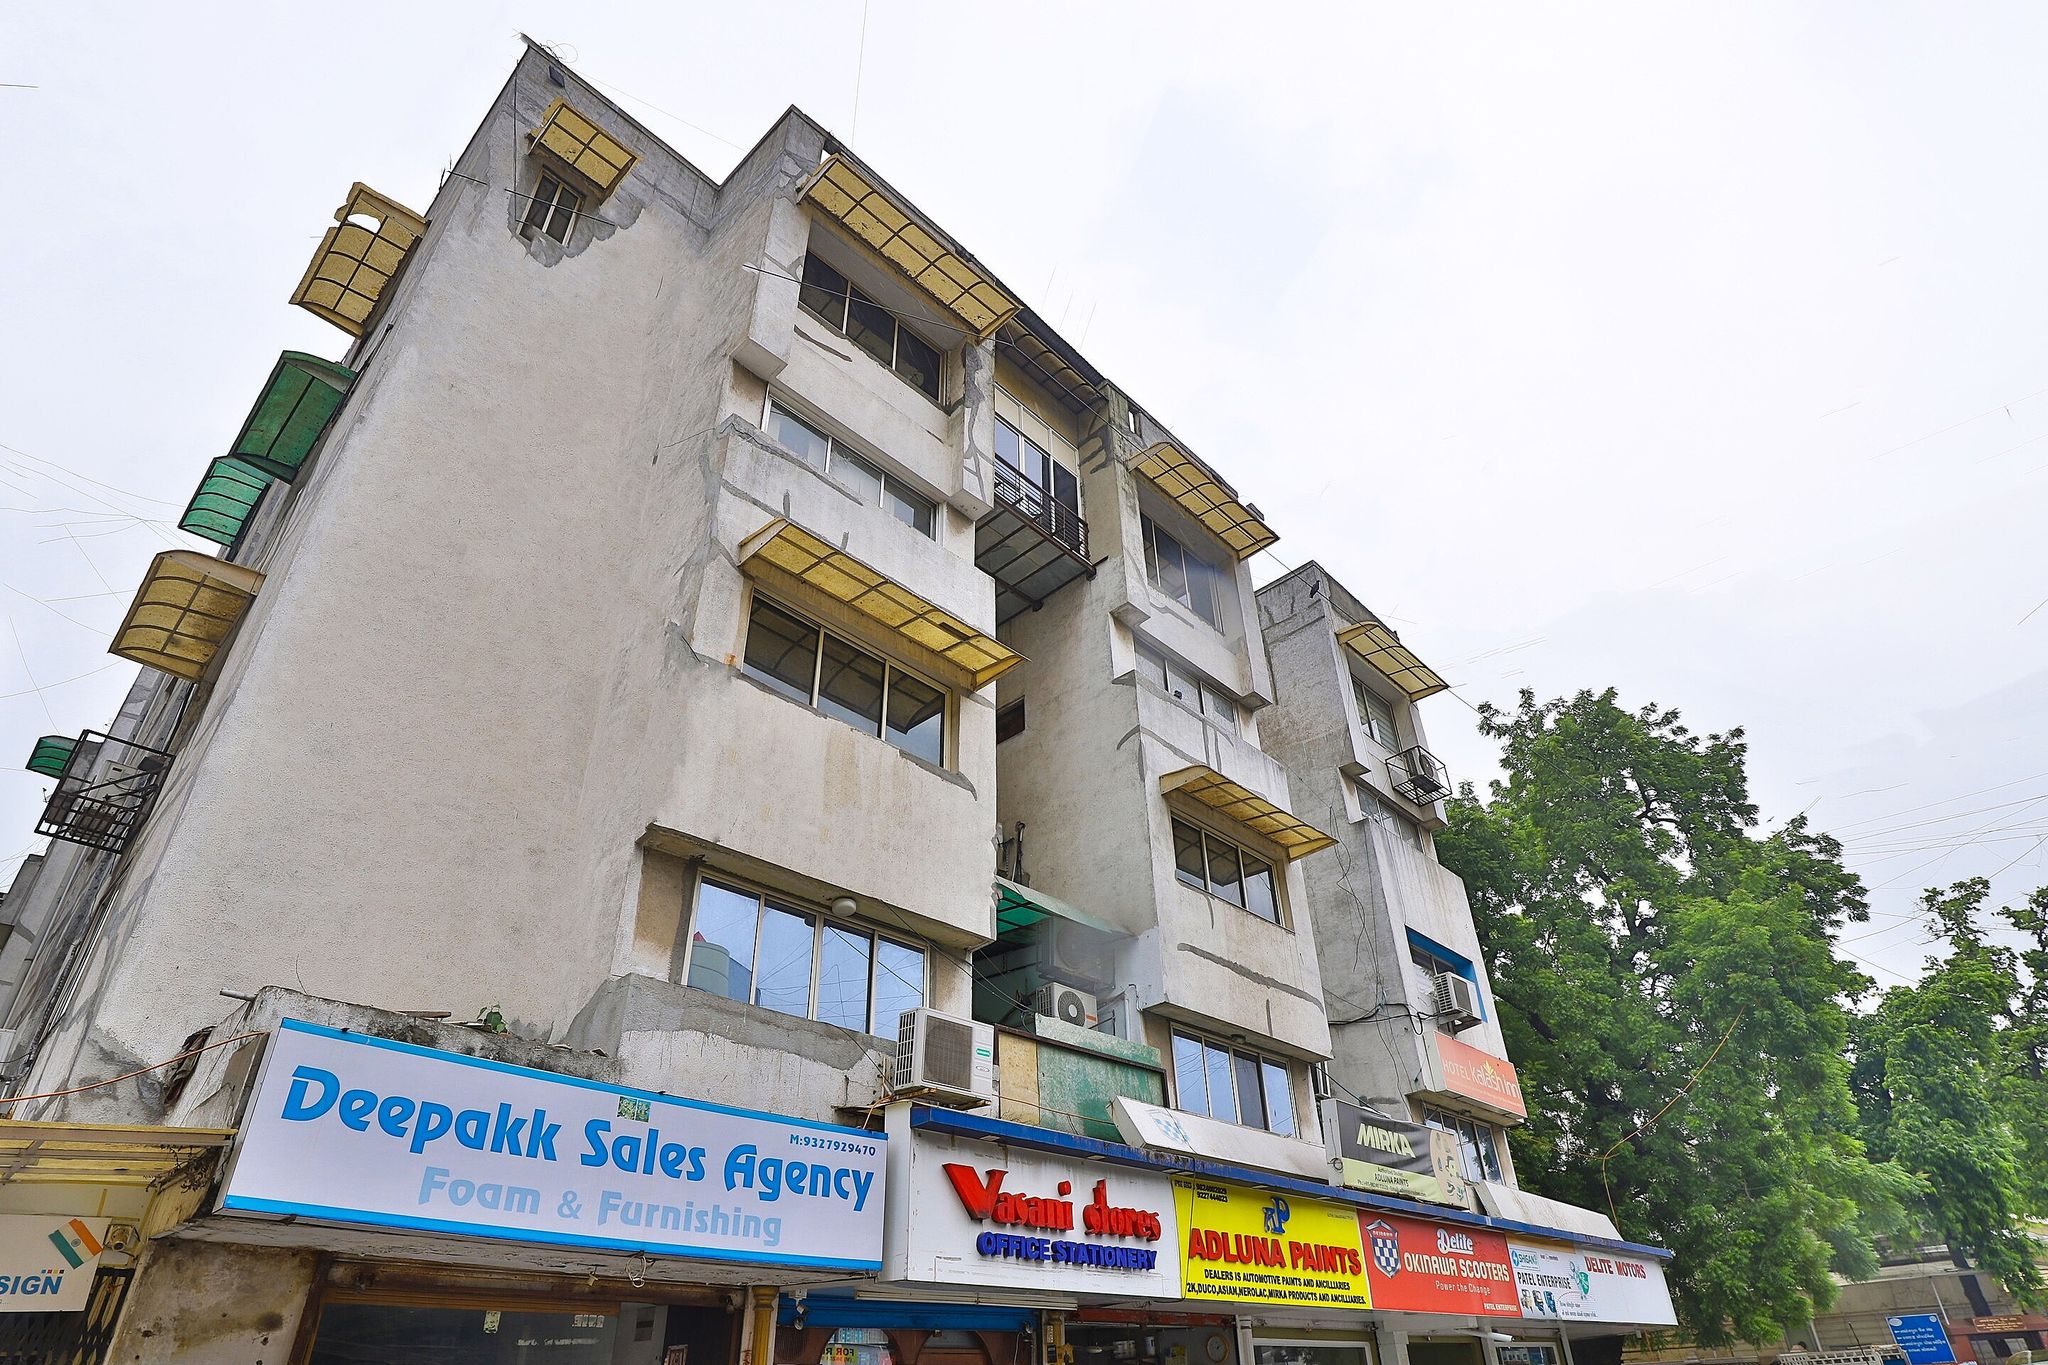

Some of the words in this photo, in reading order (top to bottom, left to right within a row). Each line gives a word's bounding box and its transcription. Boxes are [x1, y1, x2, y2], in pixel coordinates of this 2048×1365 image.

[1442, 1059, 1471, 1081] HOTEL
[281, 1065, 562, 1162] Deepakk
[580, 1118, 706, 1182] Sales
[723, 1143, 875, 1212] Agency
[789, 1133, 876, 1157] M:9327929470
[1356, 1122, 1416, 1158] MIRKA
[418, 1166, 540, 1215] Foam
[557, 1190, 583, 1220] &
[597, 1190, 781, 1247] Furnishing
[942, 1163, 1074, 1231] Vasani
[976, 1232, 1050, 1260] OFFICE
[1051, 1240, 1158, 1270] STATIONERY
[1190, 1228, 1286, 1269] ADLUNA
[1289, 1240, 1362, 1276] PAINTS
[1436, 1228, 1474, 1255] Delite
[1204, 1268, 1233, 1281] DEALERS
[1234, 1272, 1241, 1281] IS
[1243, 1273, 1281, 1285] AUTOMOTIVE
[1282, 1276, 1302, 1287] PAINTS
[1303, 1279, 1314, 1288] AND
[1404, 1252, 1458, 1277] OKINAWA
[1459, 1259, 1510, 1282] SCOOTERS
[1584, 1256, 1613, 1275] DELITE
[1615, 1260, 1647, 1279] MOTORS
[0, 1276, 62, 1295] SIGN
[1435, 1280, 1456, 1292] Power
[1457, 1282, 1468, 1292] the
[1469, 1283, 1491, 1295] Change
[1517, 1271, 1536, 1286] PATEL
[1537, 1274, 1571, 1290] ENTERPRISE
[1289, 1290, 1317, 1301] PRODUCTS
[1318, 1293, 1330, 1302] AND
